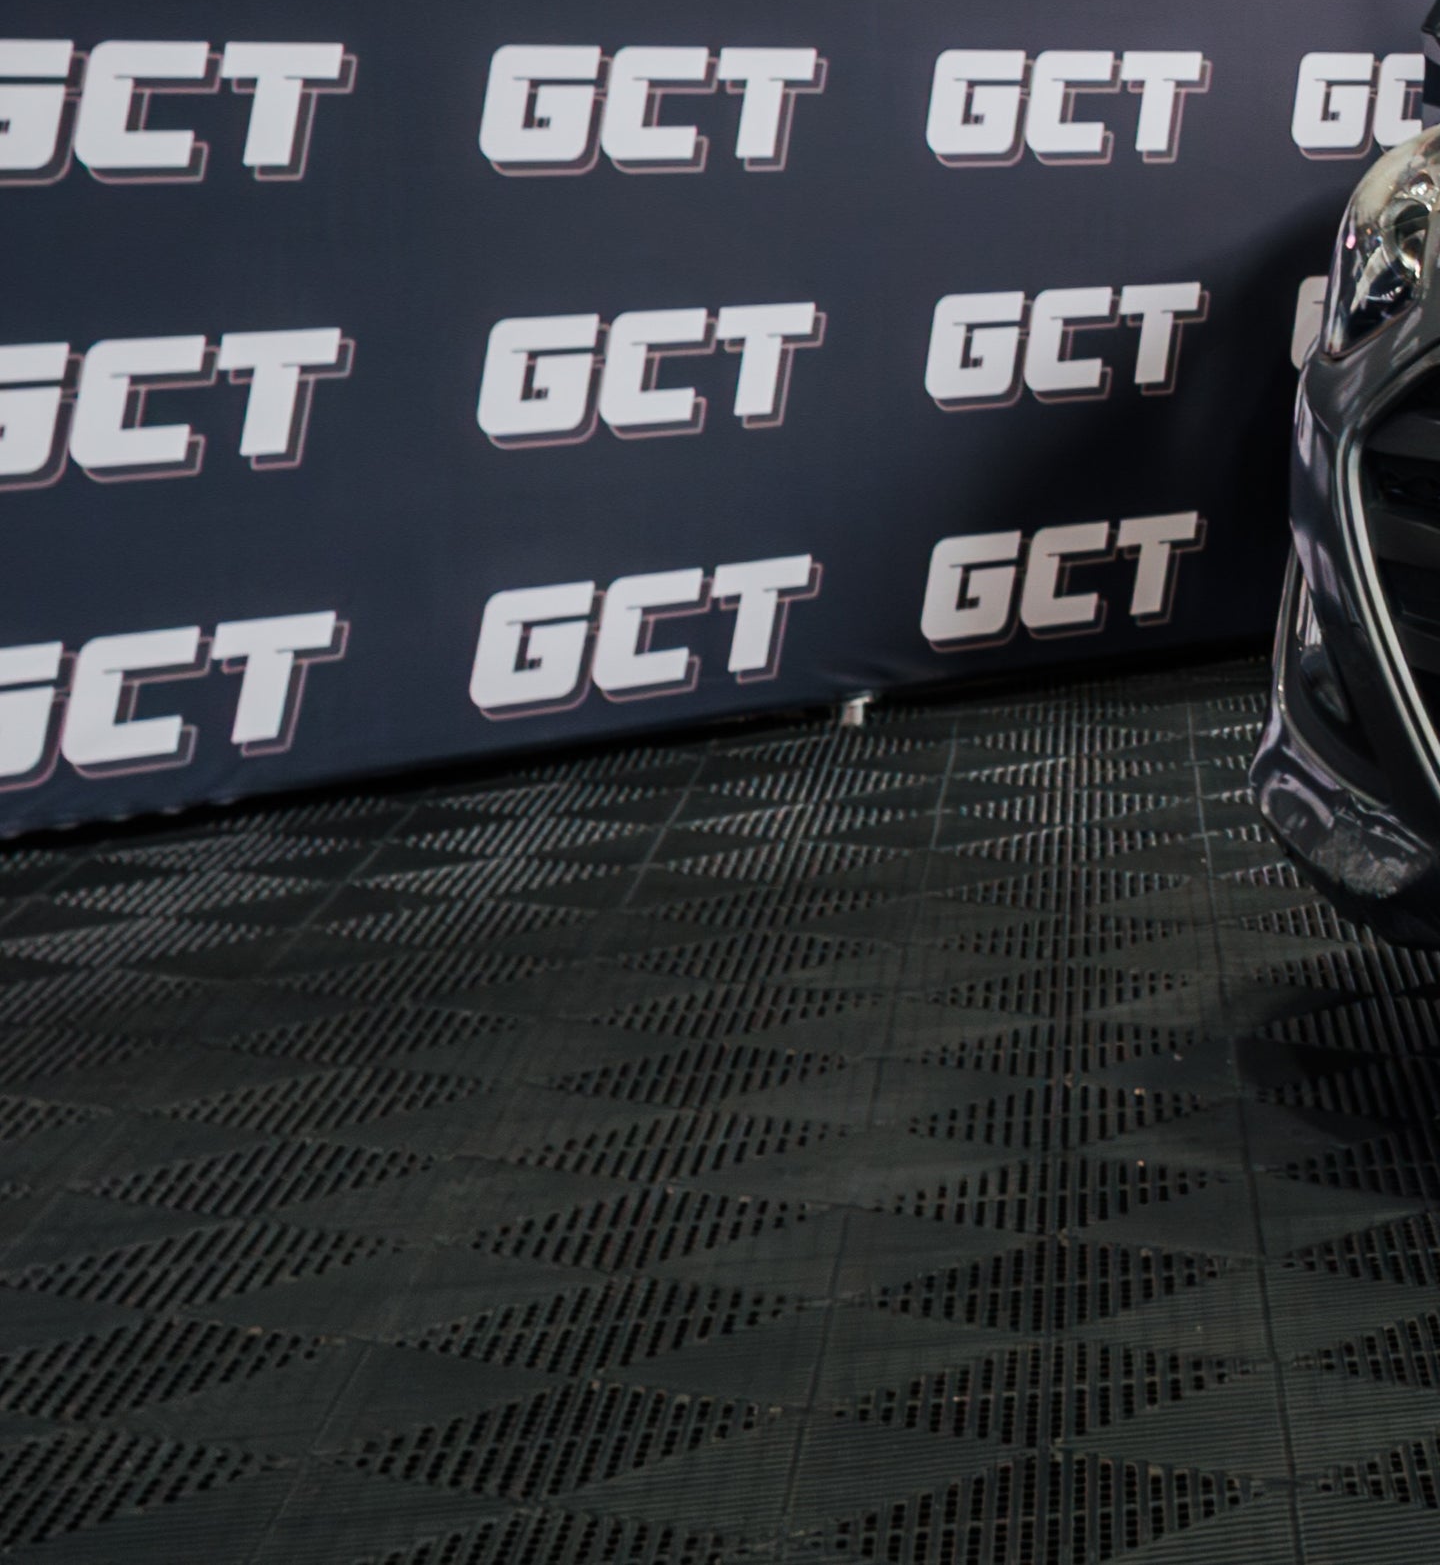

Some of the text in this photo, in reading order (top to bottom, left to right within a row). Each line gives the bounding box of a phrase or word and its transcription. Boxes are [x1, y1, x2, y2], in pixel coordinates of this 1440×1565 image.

[480, 45, 816, 161] GCT
[927, 50, 1204, 154] GCT
[1292, 53, 1421, 150] GC
[478, 303, 816, 436] GCT
[925, 282, 1200, 401] GCT
[470, 554, 812, 708] GCT
[921, 512, 1197, 641] GCT
